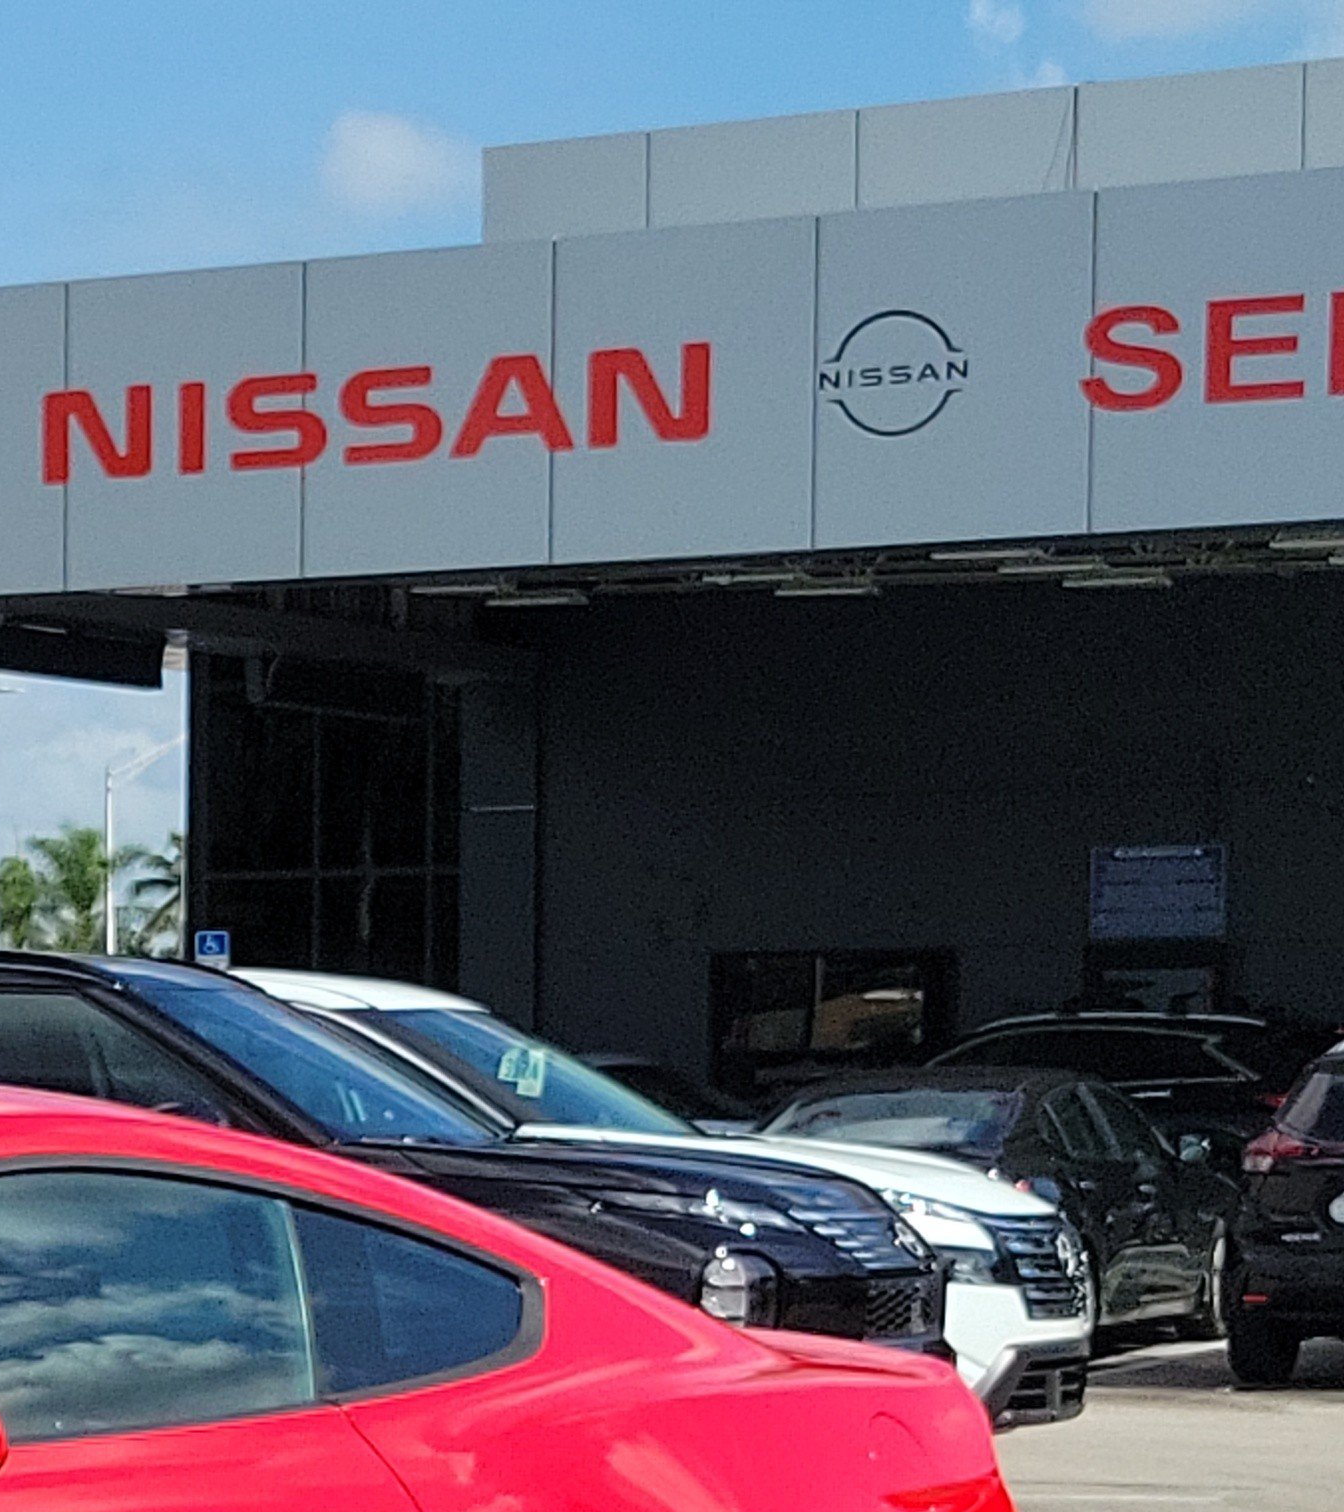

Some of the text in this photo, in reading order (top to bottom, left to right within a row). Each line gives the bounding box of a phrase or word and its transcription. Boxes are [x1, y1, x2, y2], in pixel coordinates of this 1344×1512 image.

[819, 359, 969, 390] NISSAN
[1079, 286, 1344, 412] SE
[41, 341, 712, 486] NISSAN
